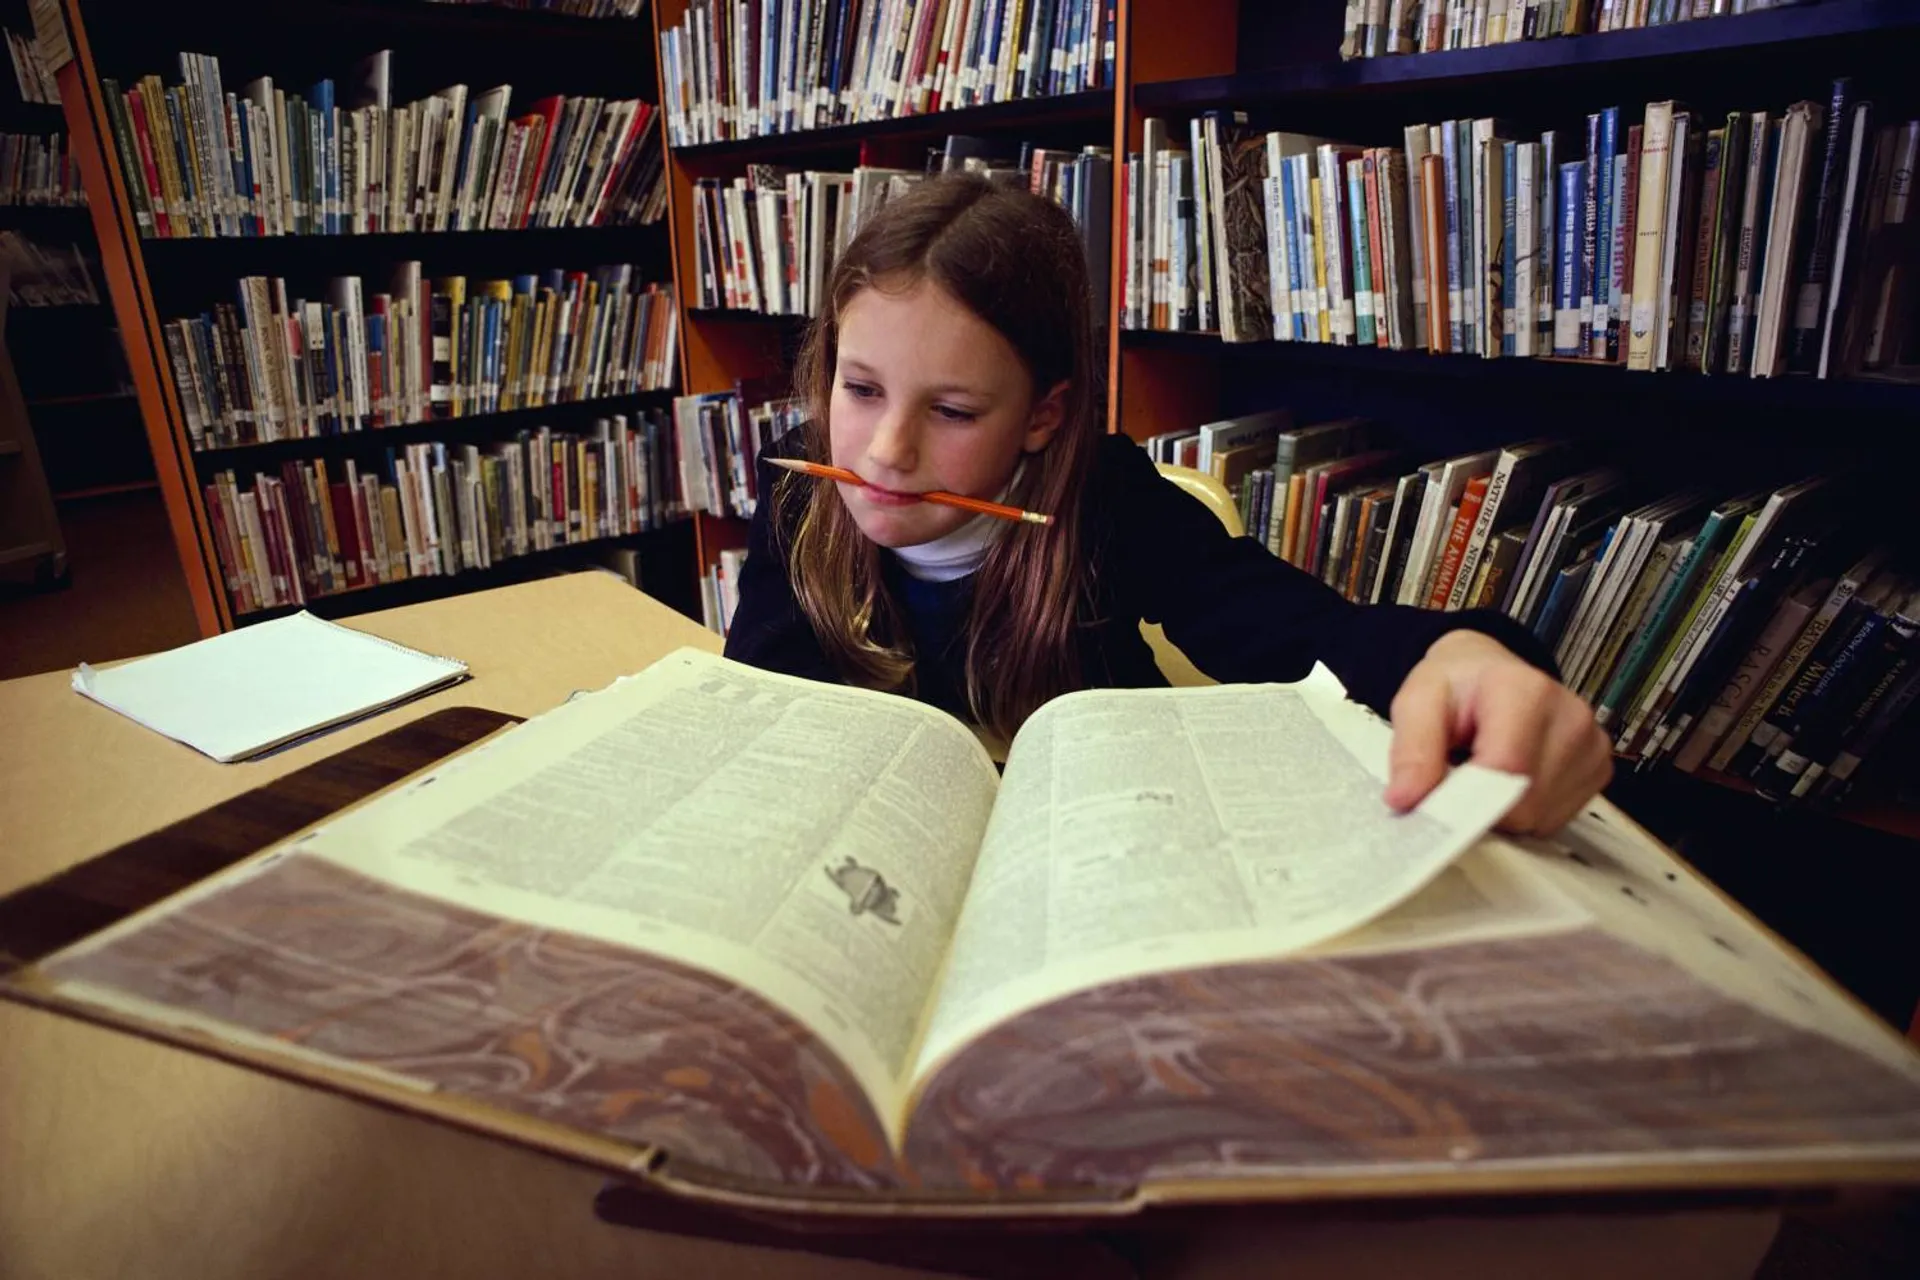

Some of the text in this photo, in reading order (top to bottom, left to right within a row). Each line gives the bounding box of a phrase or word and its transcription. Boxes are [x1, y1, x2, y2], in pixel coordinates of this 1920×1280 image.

[1272, 177, 1280, 208] BIRDS
[1613, 227, 1625, 288] BIRDS
[1449, 470, 1506, 606] NATURE'S NURSERY
[1451, 515, 1470, 543] THE
[1433, 544, 1461, 598] ANIMAL
[1718, 643, 1770, 712] RASCA
[1787, 659, 1826, 708] Mister
